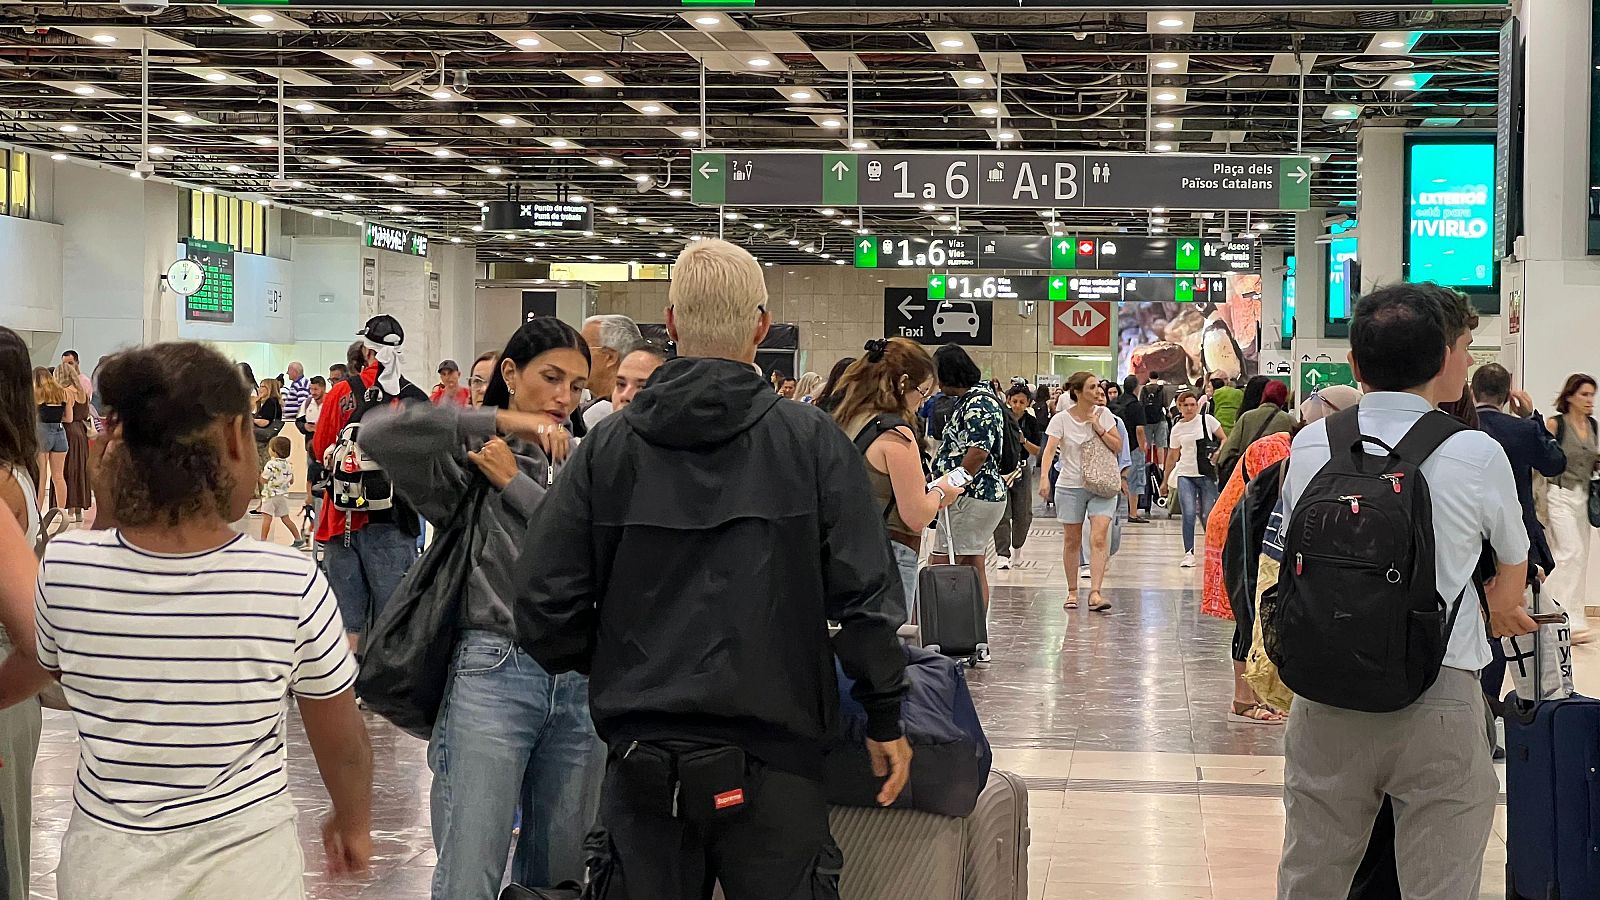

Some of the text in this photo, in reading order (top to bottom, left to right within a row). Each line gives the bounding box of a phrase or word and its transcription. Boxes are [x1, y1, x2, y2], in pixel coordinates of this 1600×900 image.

[1213, 162, 1273, 176] Plaça dels
[893, 161, 916, 199] 1
[945, 161, 970, 199] 6
[1182, 177, 1273, 189] Països Catalans
[1419, 191, 1487, 206] EXTERIOR
[1415, 206, 1472, 219] está para
[948, 239, 965, 248] Vías
[1228, 242, 1250, 251] Aseos
[897, 240, 914, 266] 1
[928, 240, 946, 266] 6
[948, 249, 966, 258] Vies
[1072, 309, 1092, 327] M
[898, 325, 924, 337] Taxi
[717, 794, 742, 804] Supreme
